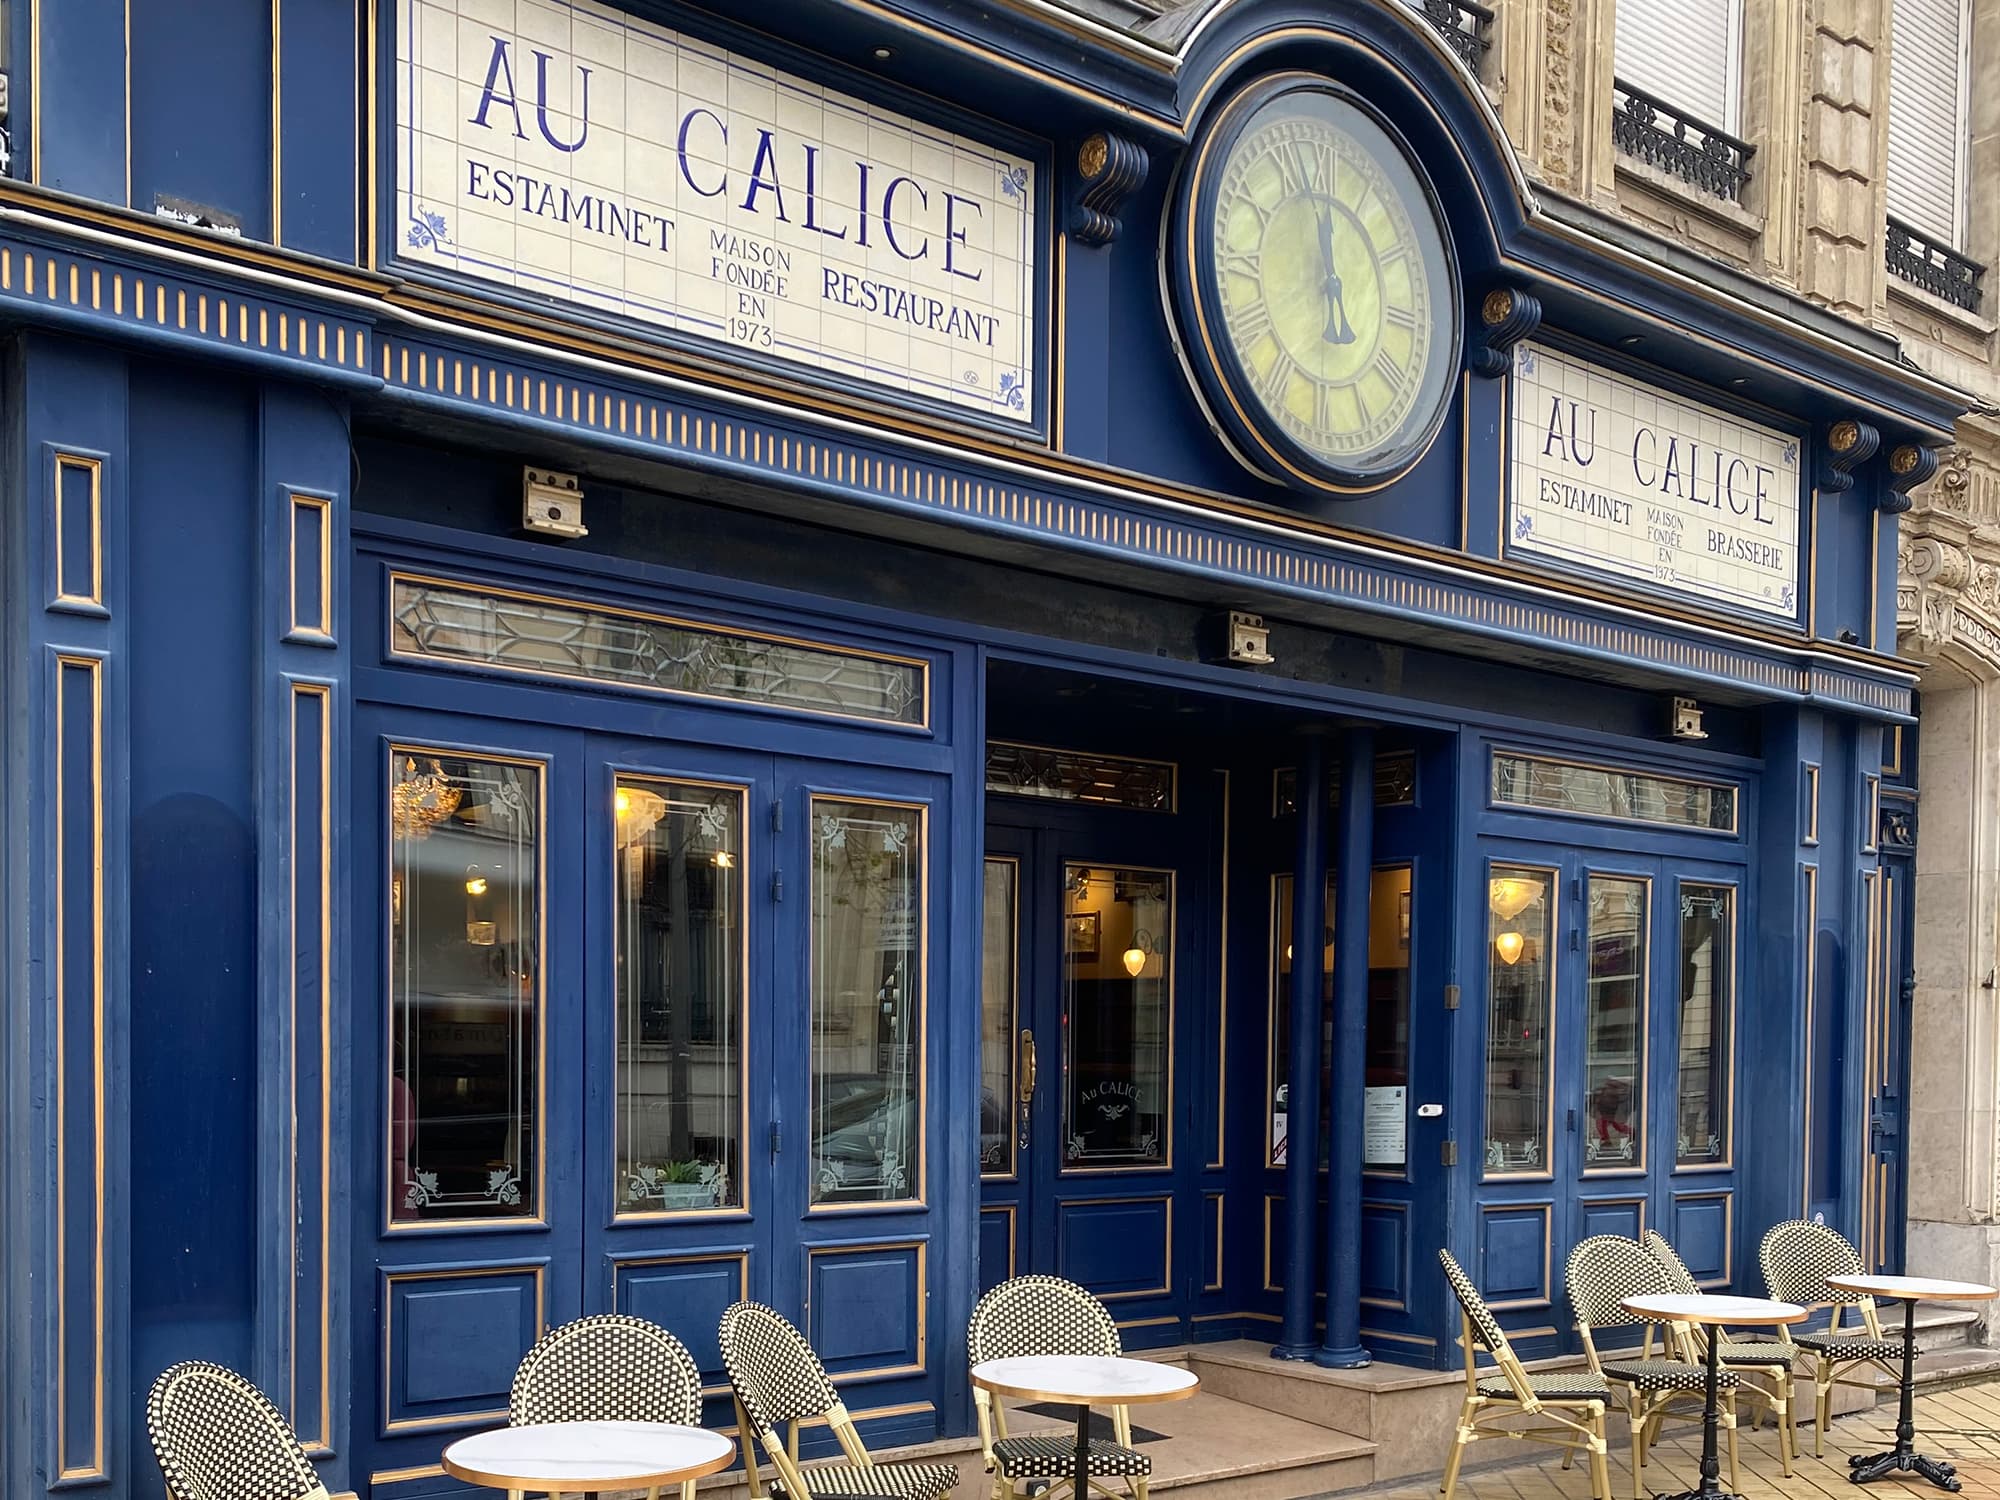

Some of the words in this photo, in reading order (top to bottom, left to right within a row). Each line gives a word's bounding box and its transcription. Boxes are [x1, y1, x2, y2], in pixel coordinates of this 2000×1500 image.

[467, 36, 594, 153] AU
[676, 108, 984, 282] CALICE
[467, 159, 675, 253] ESTAMINET
[710, 228, 790, 272] MAISON
[711, 256, 788, 298] FONDÉE
[738, 292, 766, 319] EN
[821, 266, 1000, 347] RESTAURANT
[728, 316, 772, 347] 1973
[1542, 396, 1597, 467] AU
[1633, 428, 1775, 526] CALICE
[1539, 477, 1633, 527] ESTAMINET
[1647, 507, 1685, 531] MAISON
[1648, 525, 1683, 549] FONDÉE
[1659, 547, 1672, 563] EN
[1707, 528, 1784, 572] BRASSERIE
[1654, 564, 1675, 582] 1973
[1100, 1081, 1144, 1103] CALICE
